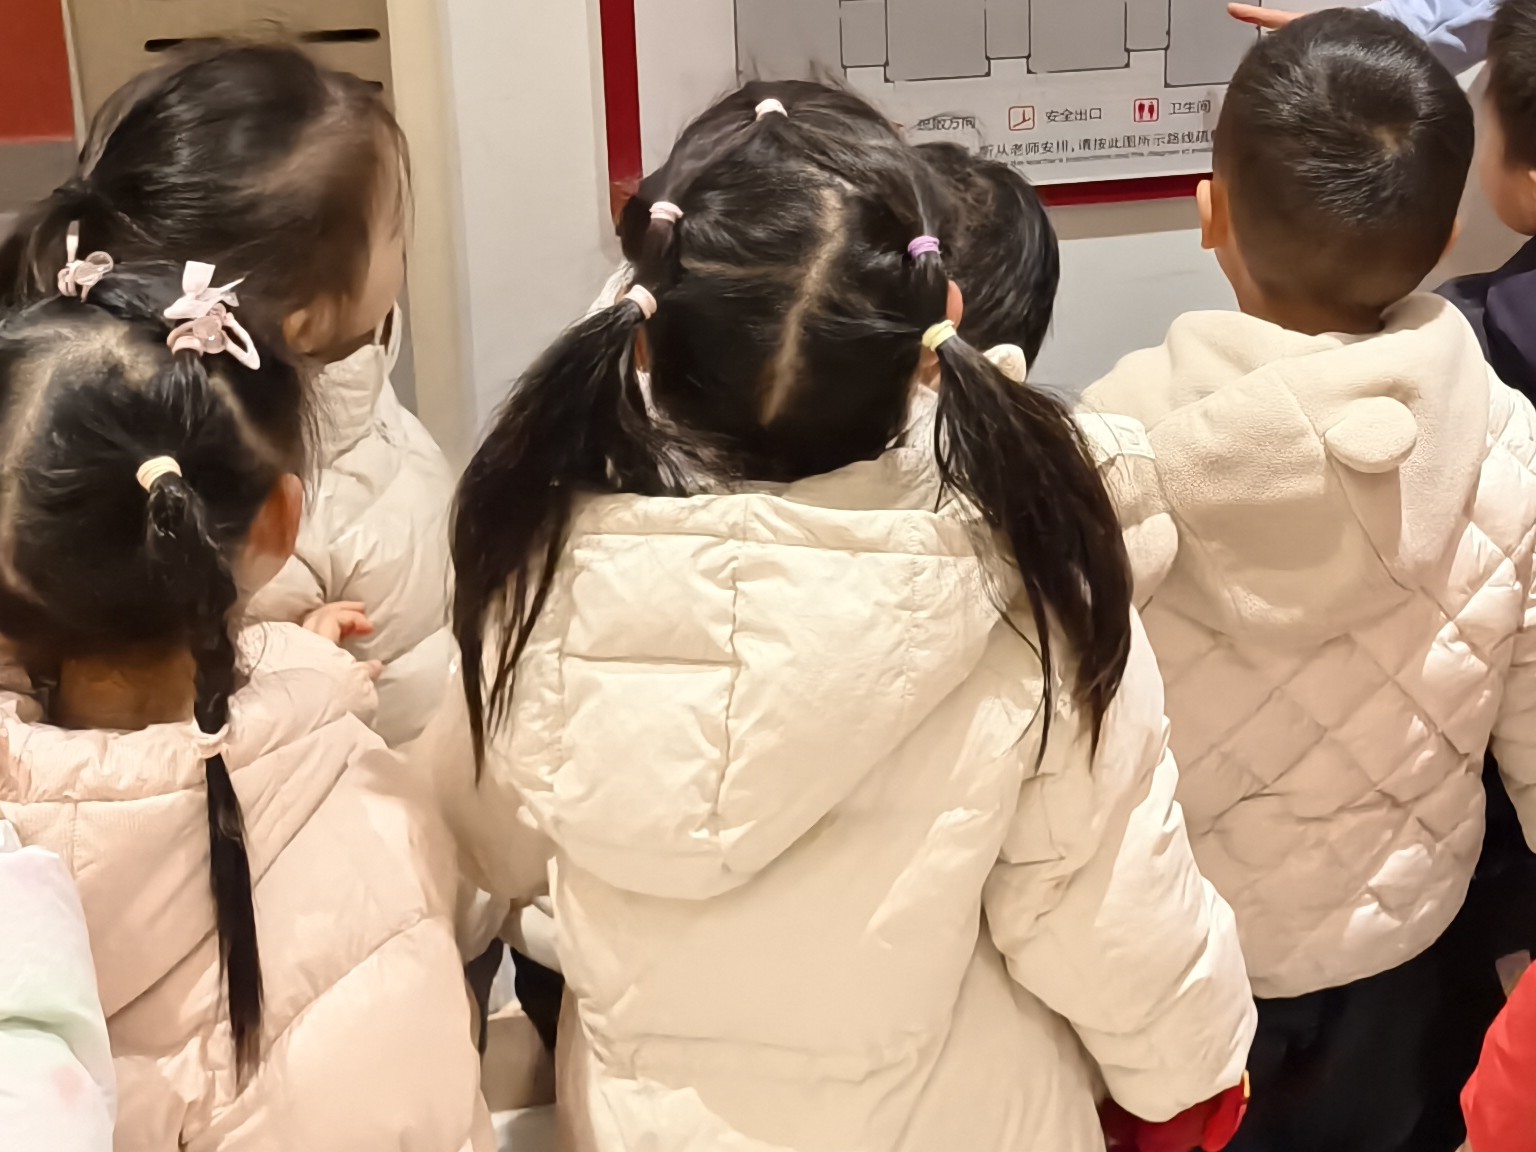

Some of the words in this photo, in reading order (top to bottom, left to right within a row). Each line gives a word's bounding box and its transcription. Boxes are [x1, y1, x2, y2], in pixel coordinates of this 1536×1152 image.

[1045, 107, 1103, 124] 安全出口
[1169, 99, 1212, 116] 卫生间
